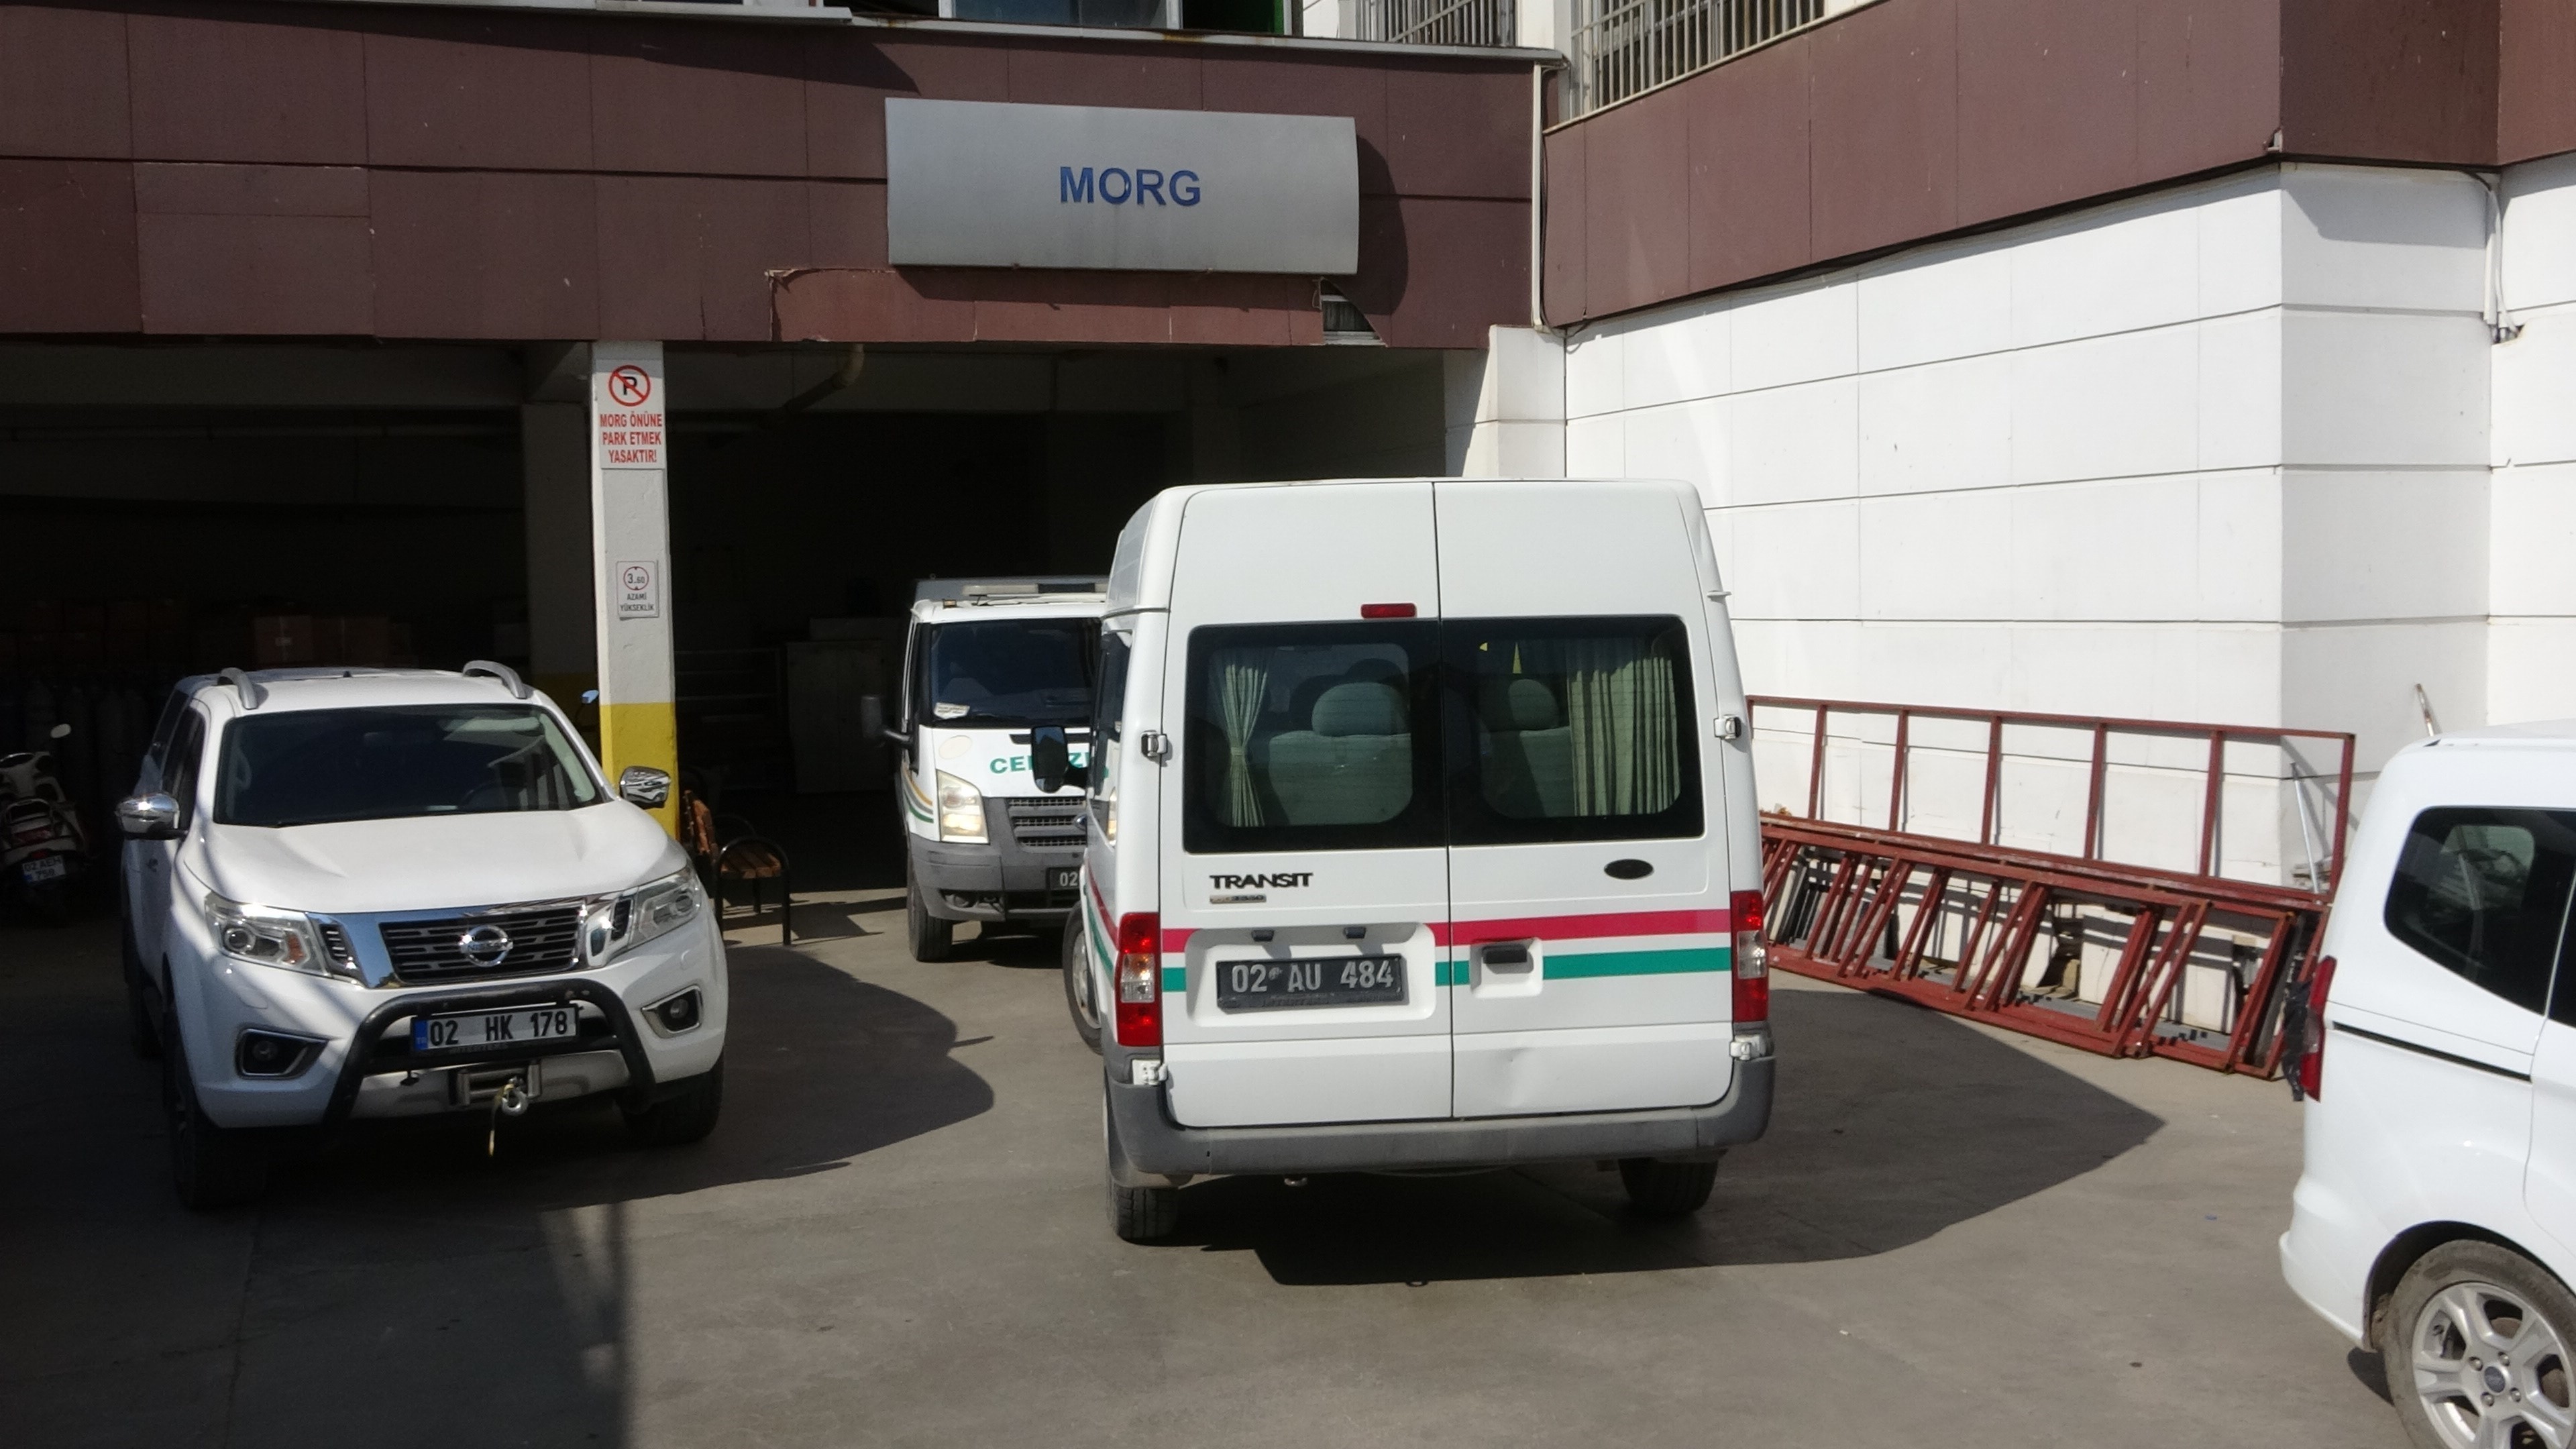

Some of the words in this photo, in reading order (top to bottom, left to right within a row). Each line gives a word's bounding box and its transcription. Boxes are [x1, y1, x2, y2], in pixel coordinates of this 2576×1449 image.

[1060, 166, 1201, 207] MORG
[600, 414, 627, 427] MORG
[630, 411, 662, 427] ÖNÜNE
[602, 431, 627, 445] PARK
[630, 431, 661, 445] ETMEK
[608, 449, 657, 463] YASAKTIR!
[1210, 872, 1313, 889] TRANSIT
[1232, 964, 1268, 993] 02
[1287, 963, 1322, 992] AU
[1340, 960, 1393, 989] 484
[431, 1020, 459, 1046] 02
[485, 1015, 514, 1041] HK
[529, 1011, 568, 1037] 178
